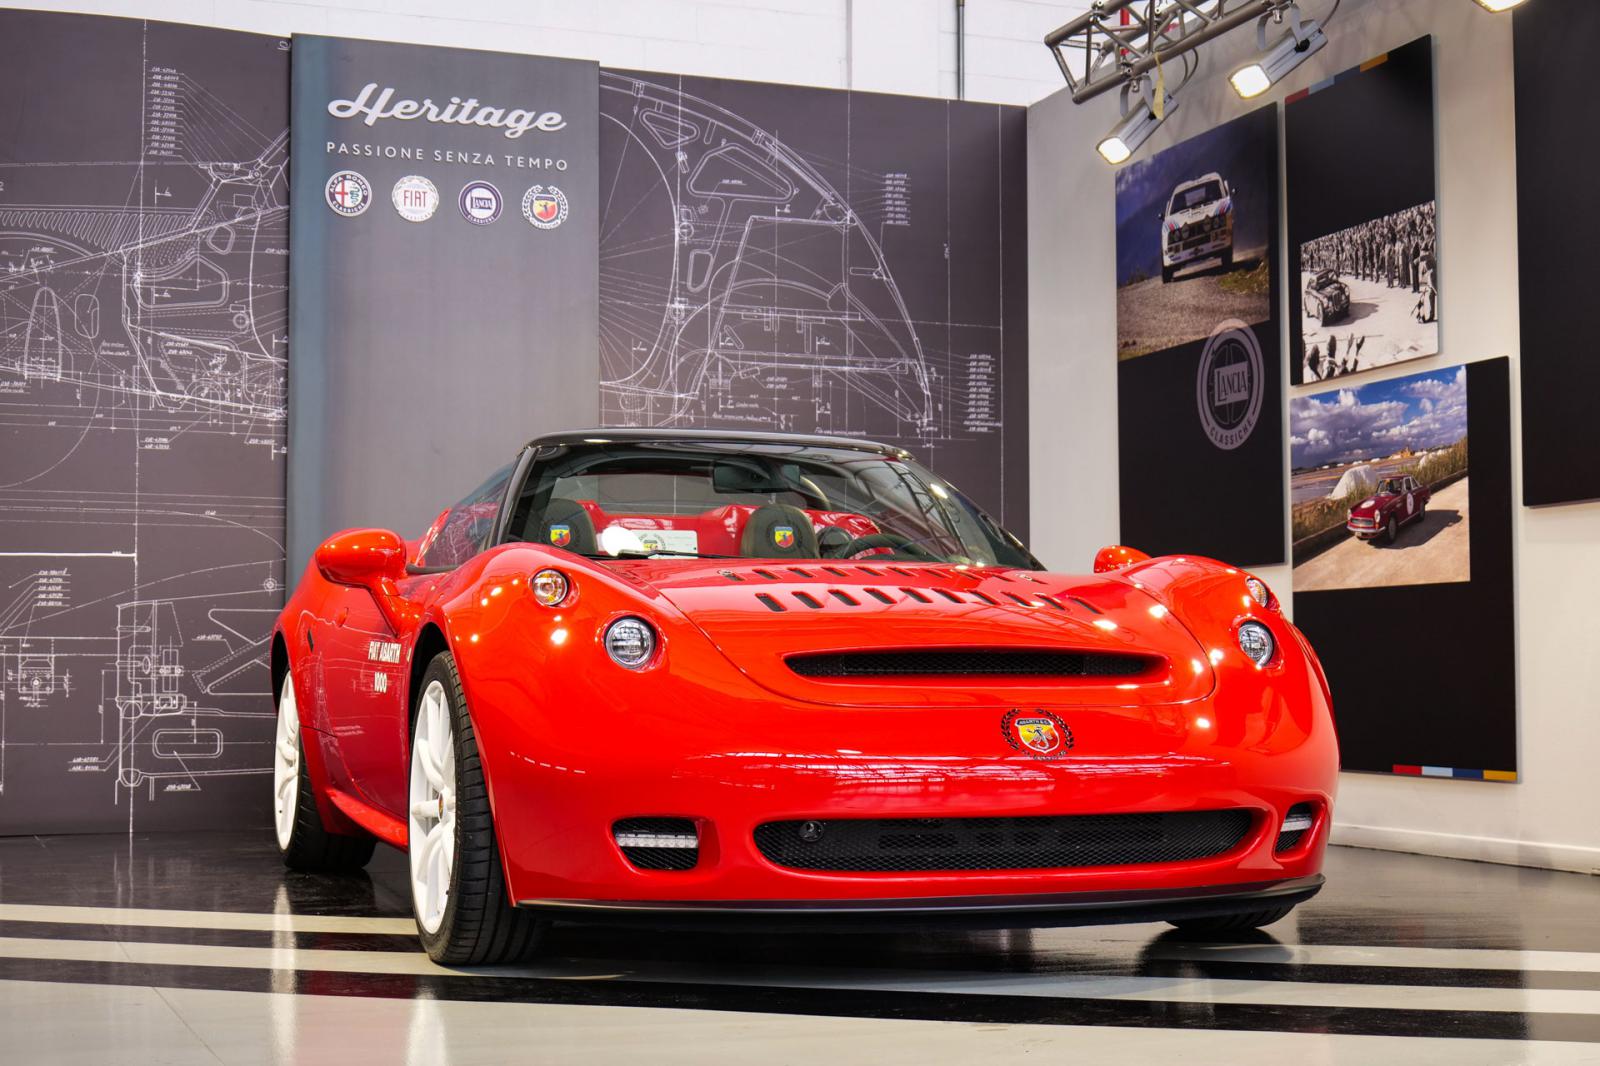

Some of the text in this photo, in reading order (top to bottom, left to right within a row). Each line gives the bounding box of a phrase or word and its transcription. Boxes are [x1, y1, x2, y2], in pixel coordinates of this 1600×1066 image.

[327, 82, 567, 139] Heritage
[327, 141, 568, 171] PASSIONE SENZA TEMPO
[403, 189, 428, 209] FIAT
[1217, 370, 1247, 401] LANCIA
[1209, 418, 1253, 446] CLASSICHE
[368, 641, 380, 661] FIAT
